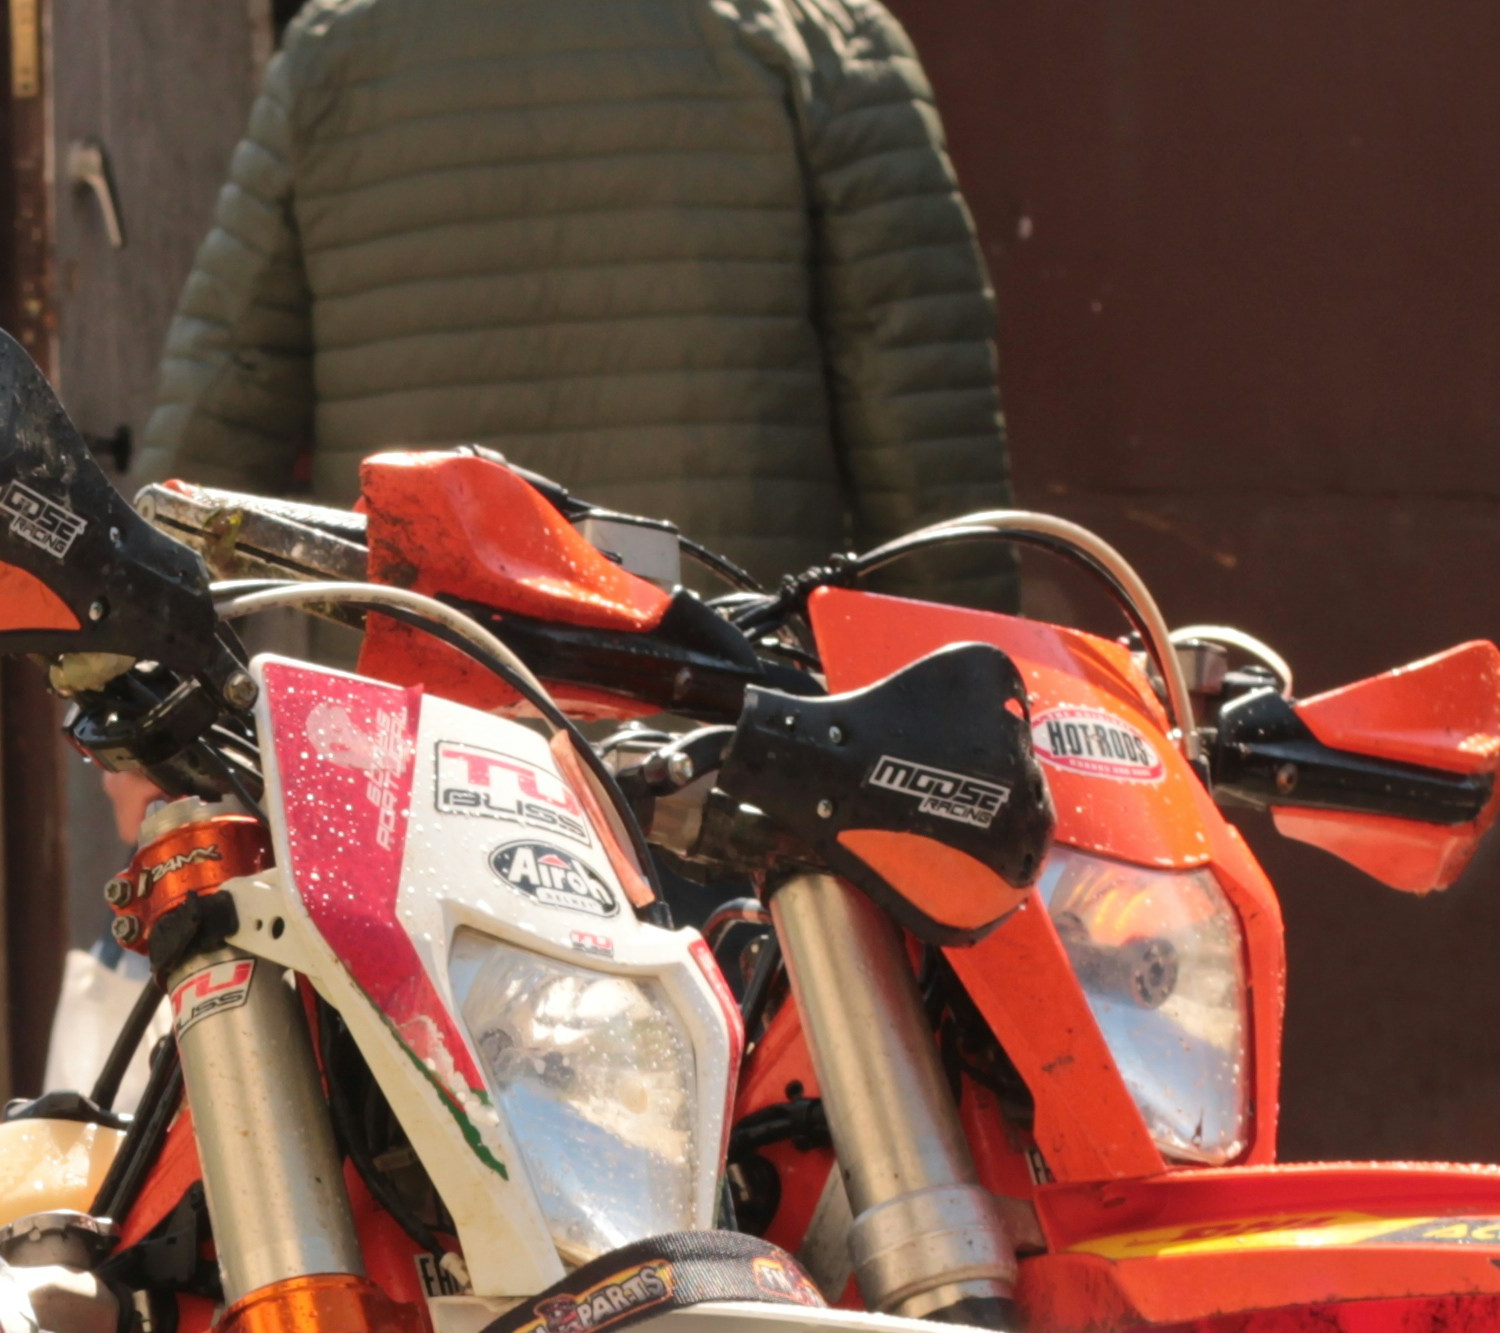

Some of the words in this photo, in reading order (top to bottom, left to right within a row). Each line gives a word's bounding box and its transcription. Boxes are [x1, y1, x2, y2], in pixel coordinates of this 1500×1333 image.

[871, 756, 1007, 815] MOOSE
[443, 788, 587, 839] BLISS
[923, 799, 992, 824] RACING
[150, 845, 222, 883] 24MX
[507, 846, 614, 906] Airoh
[176, 989, 244, 1030] LISS
[575, 1266, 664, 1329] PARTS
